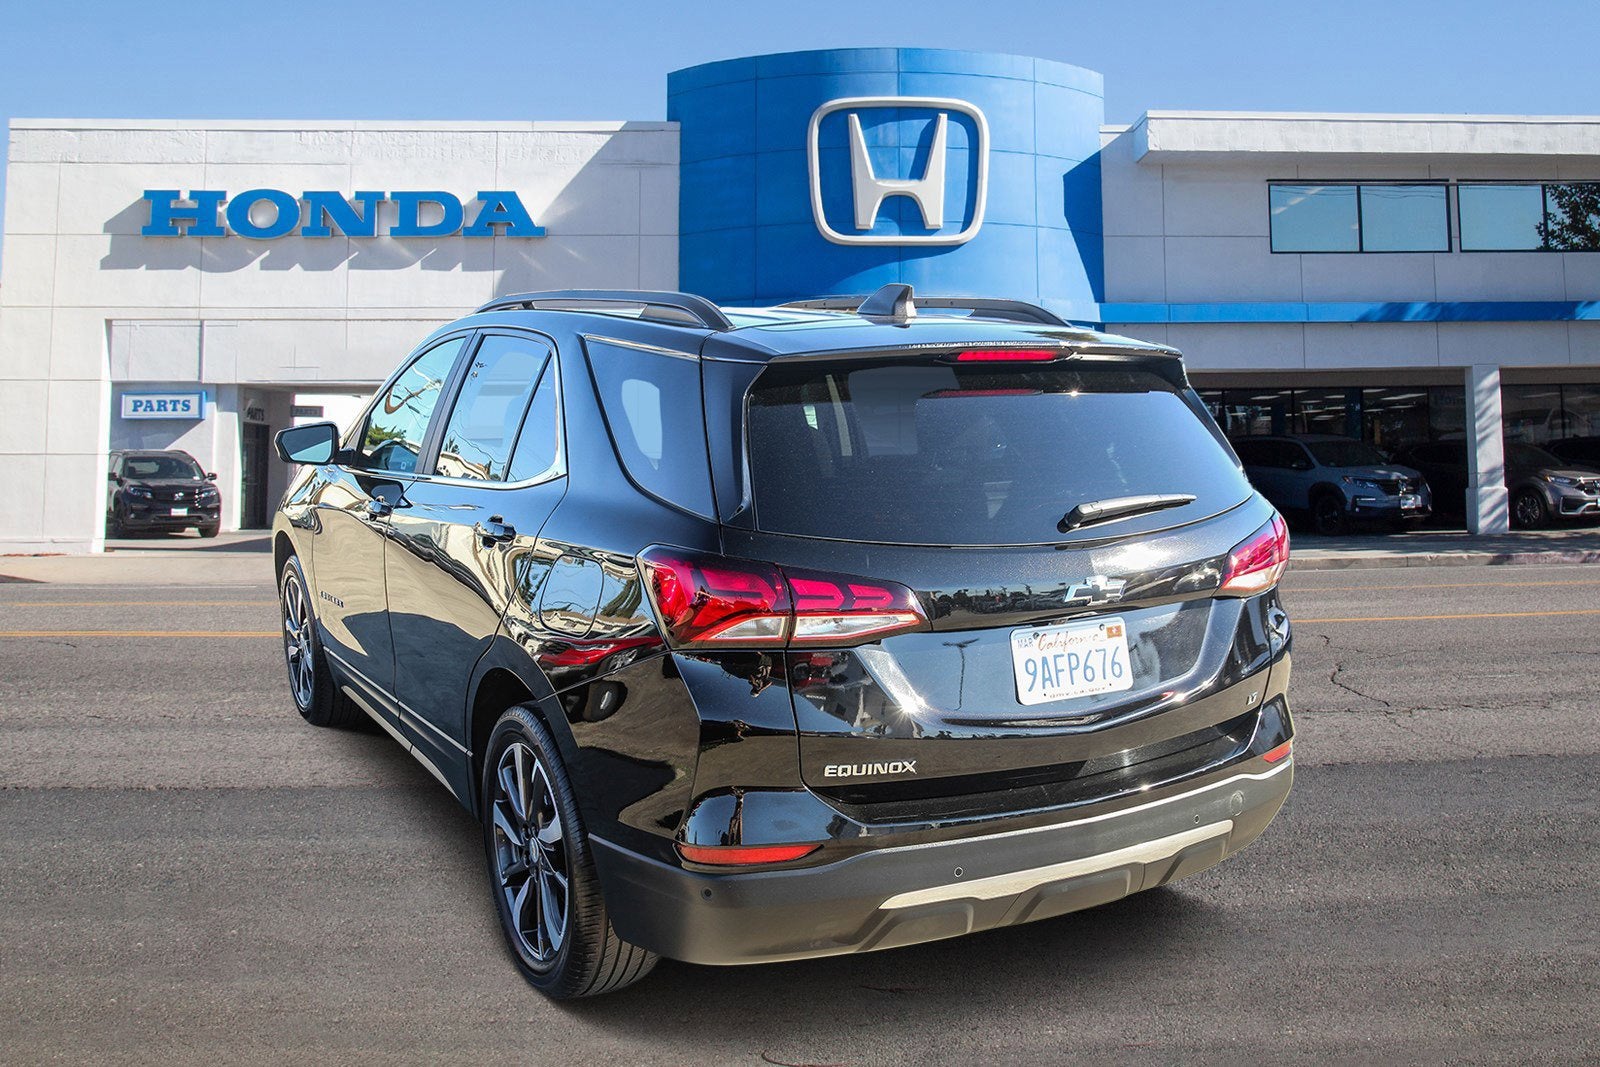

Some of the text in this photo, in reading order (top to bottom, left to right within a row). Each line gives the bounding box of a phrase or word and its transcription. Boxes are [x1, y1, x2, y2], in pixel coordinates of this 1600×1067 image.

[141, 189, 547, 239] HONDA
[132, 400, 191, 412] PARTS
[1024, 646, 1123, 692] 9AFP676
[824, 760, 917, 777] EQUINOX
